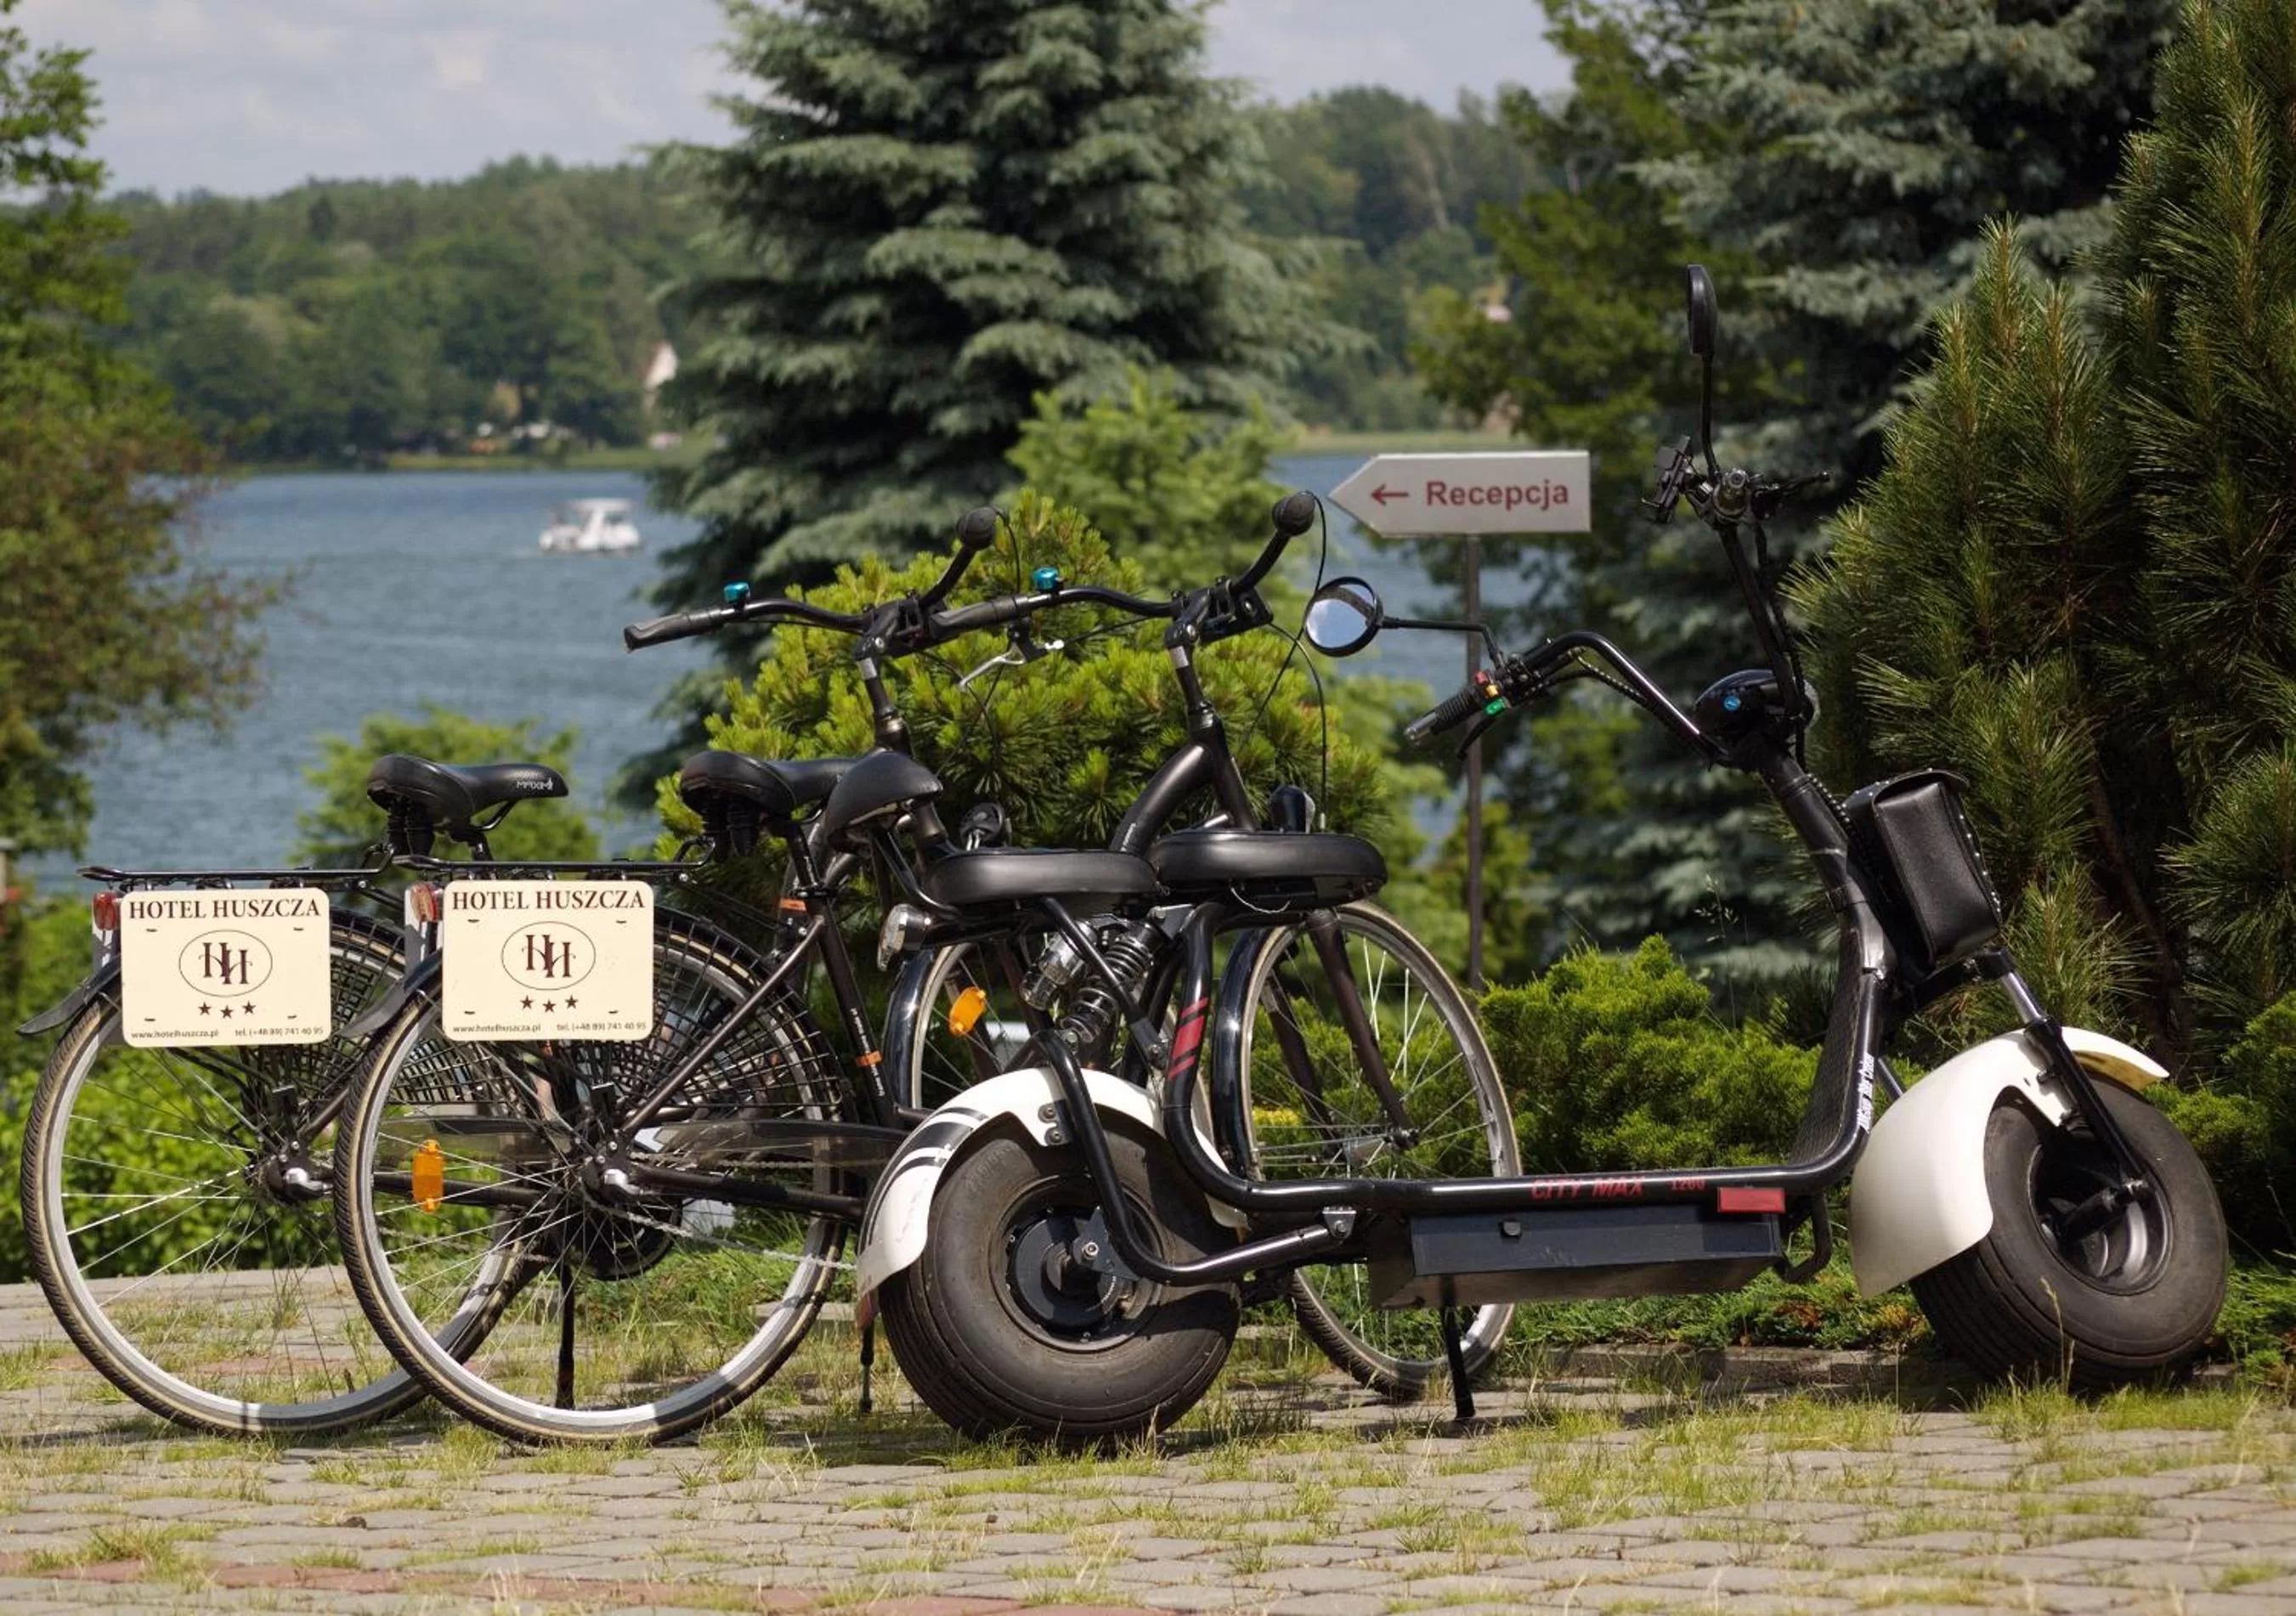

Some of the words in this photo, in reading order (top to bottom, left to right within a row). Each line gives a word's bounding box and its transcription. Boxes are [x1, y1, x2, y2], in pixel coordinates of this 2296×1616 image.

[1425, 478, 1569, 511] Recepcja
[129, 900, 206, 919] HOTEL
[212, 898, 320, 918] HUSZCZA
[452, 891, 529, 910] HOTEL
[536, 890, 646, 909] HUSZCZA
[1531, 1178, 1584, 1200] CITY
[1592, 1176, 1645, 1198] MAX
